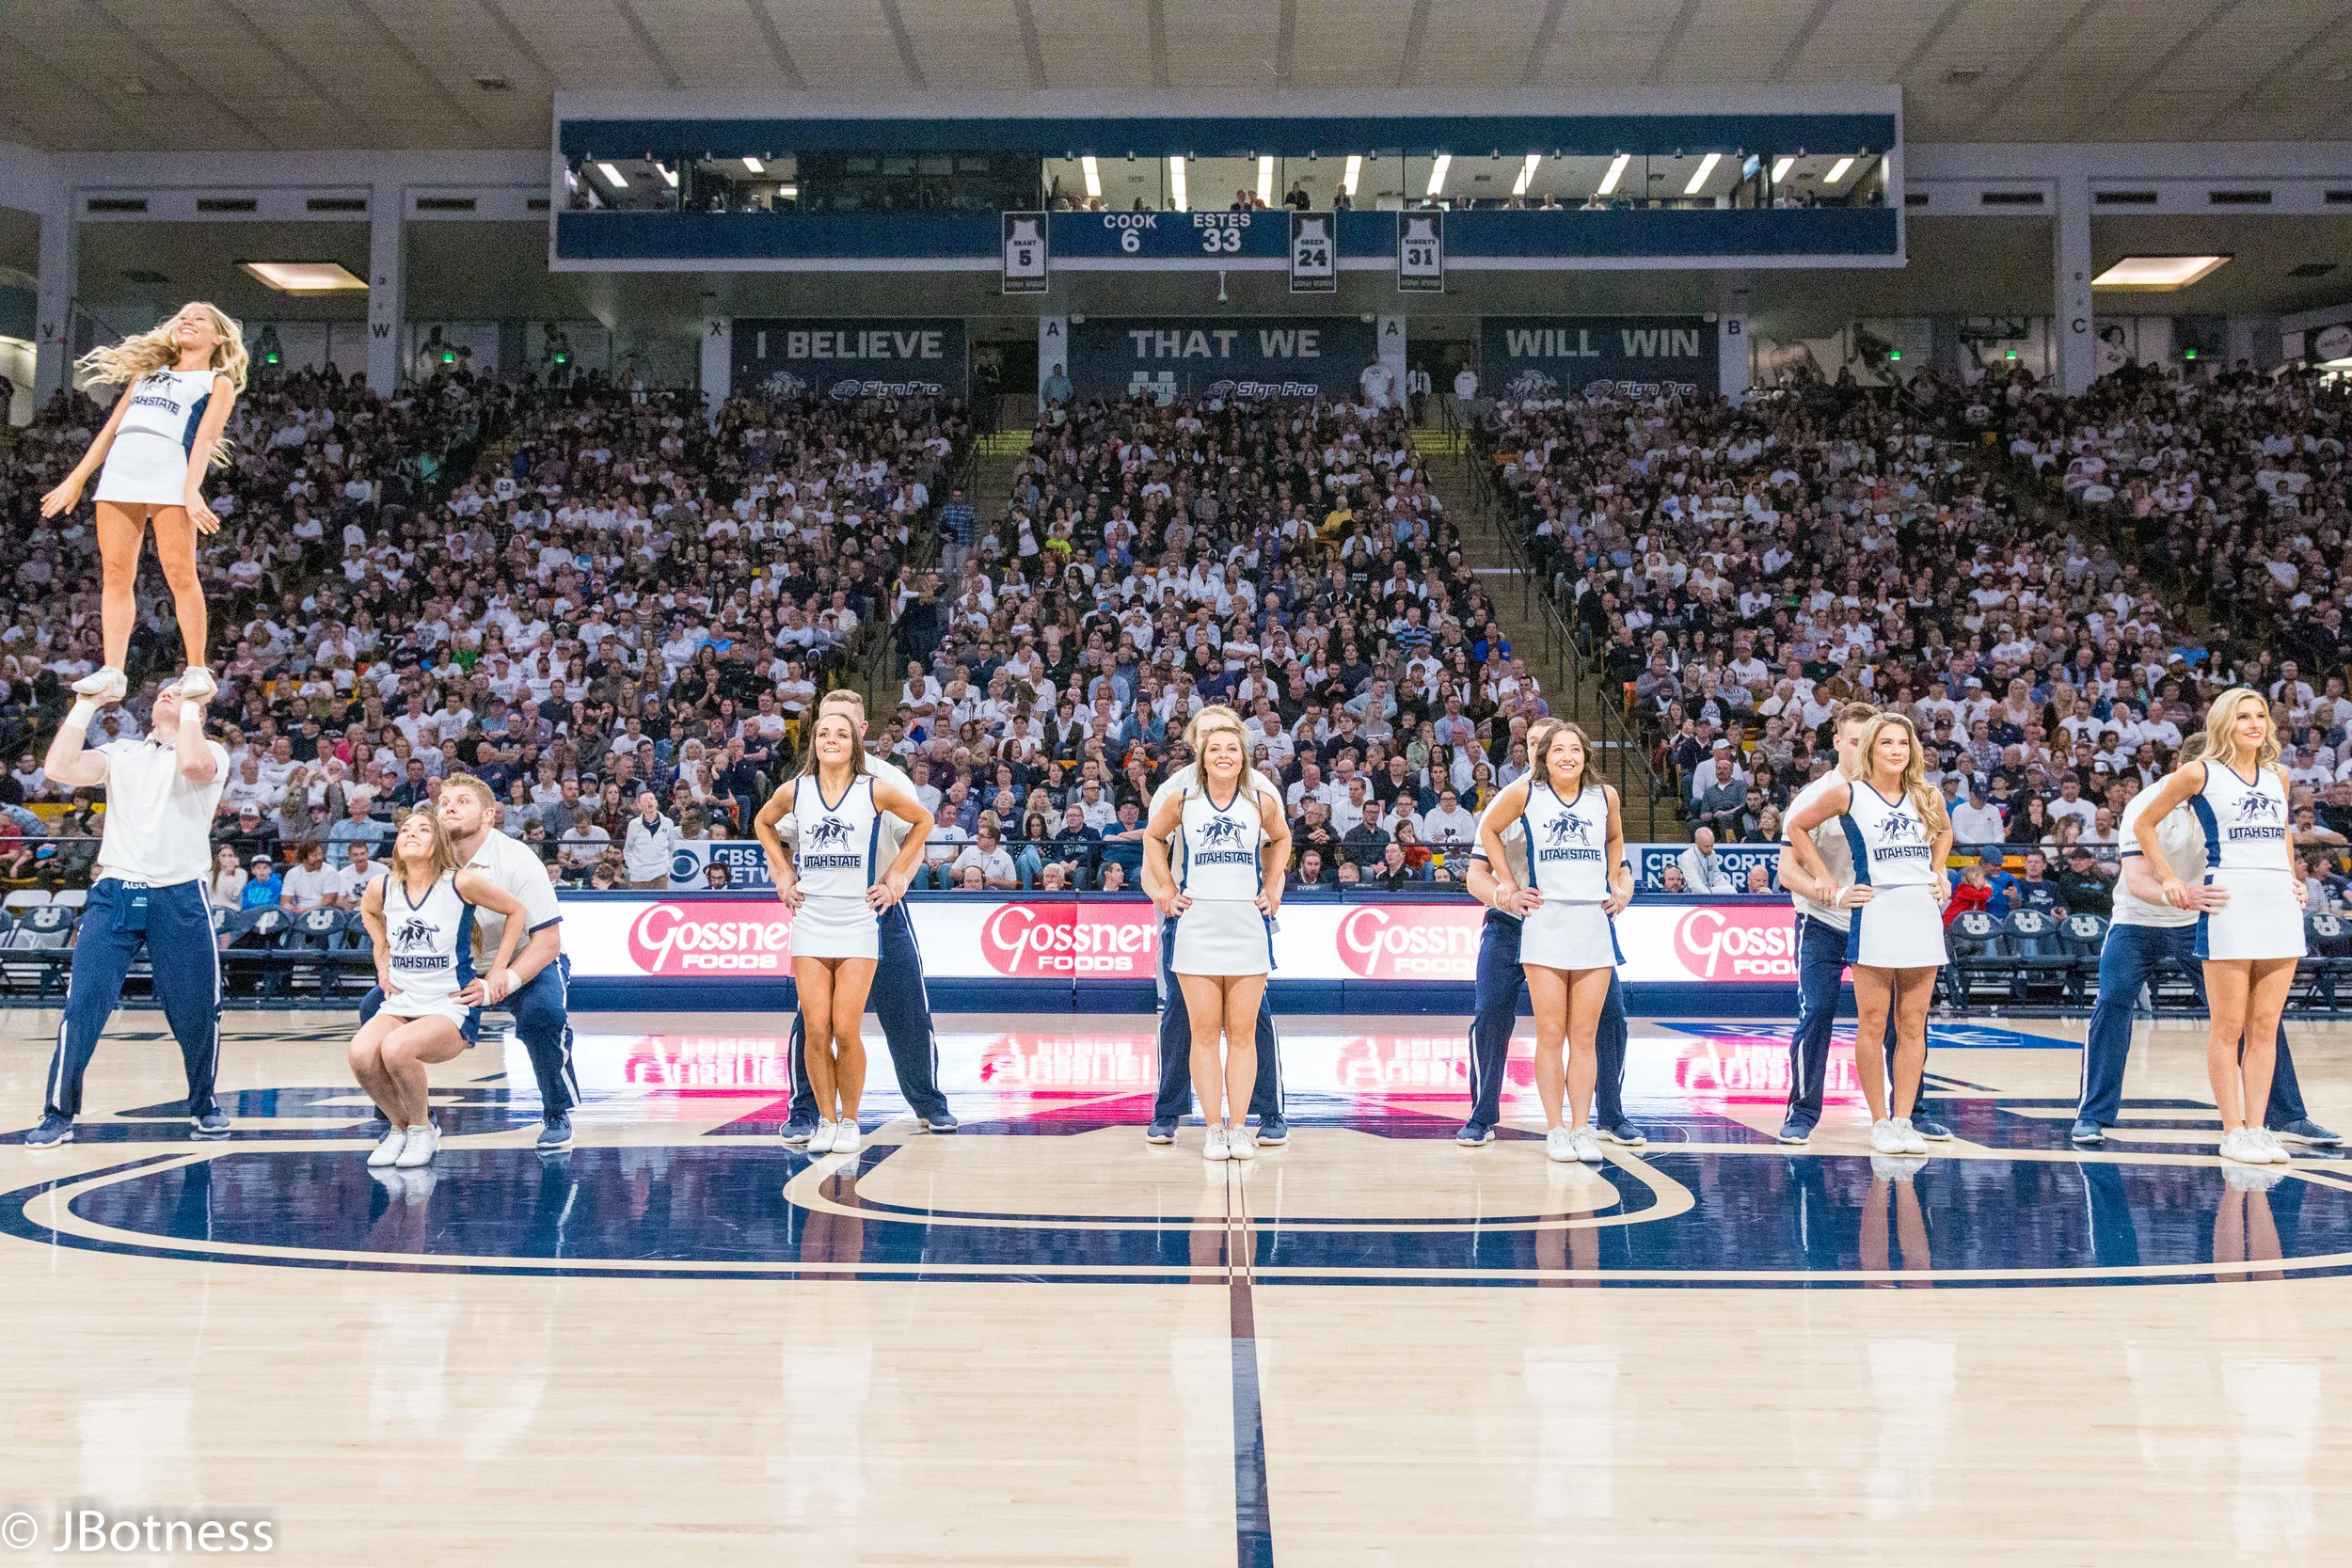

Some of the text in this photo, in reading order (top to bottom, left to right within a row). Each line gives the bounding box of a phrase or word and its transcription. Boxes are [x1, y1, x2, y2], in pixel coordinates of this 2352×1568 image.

[1104, 214, 1157, 229] COOK
[1193, 214, 1251, 228] ESTES
[1121, 228, 1140, 252] 6
[1202, 228, 1241, 252] 33
[1019, 249, 1032, 266] 5
[1298, 248, 1327, 267] 24
[1408, 248, 1433, 265] 31
[373, 324, 390, 338] W
[710, 321, 722, 336] X
[1047, 321, 1059, 337] A
[1386, 321, 1399, 336] A
[1728, 320, 1740, 335] B
[2073, 318, 2086, 334] C
[756, 330, 943, 359] I BELIEVE
[1129, 329, 1321, 358] THAT WE
[1506, 328, 1700, 357] WILL WIN
[1281, 381, 1318, 396] Pro
[148, 395, 182, 416] STATE
[2228, 826, 2261, 841] UTAH
[714, 849, 757, 866] CBS
[803, 854, 861, 869] UTAH STATE
[1195, 850, 1254, 866] UTAH STATE
[1539, 847, 1601, 863] UTAH STATE
[1873, 846, 1931, 862] UTAH STATE
[638, 904, 792, 973] Gossne
[991, 906, 1157, 973] Gossner
[415, 954, 450, 971] STATE
[682, 954, 778, 969] FOODS
[1038, 956, 1134, 971] FOODS
[1394, 958, 1476, 974] FOOD
